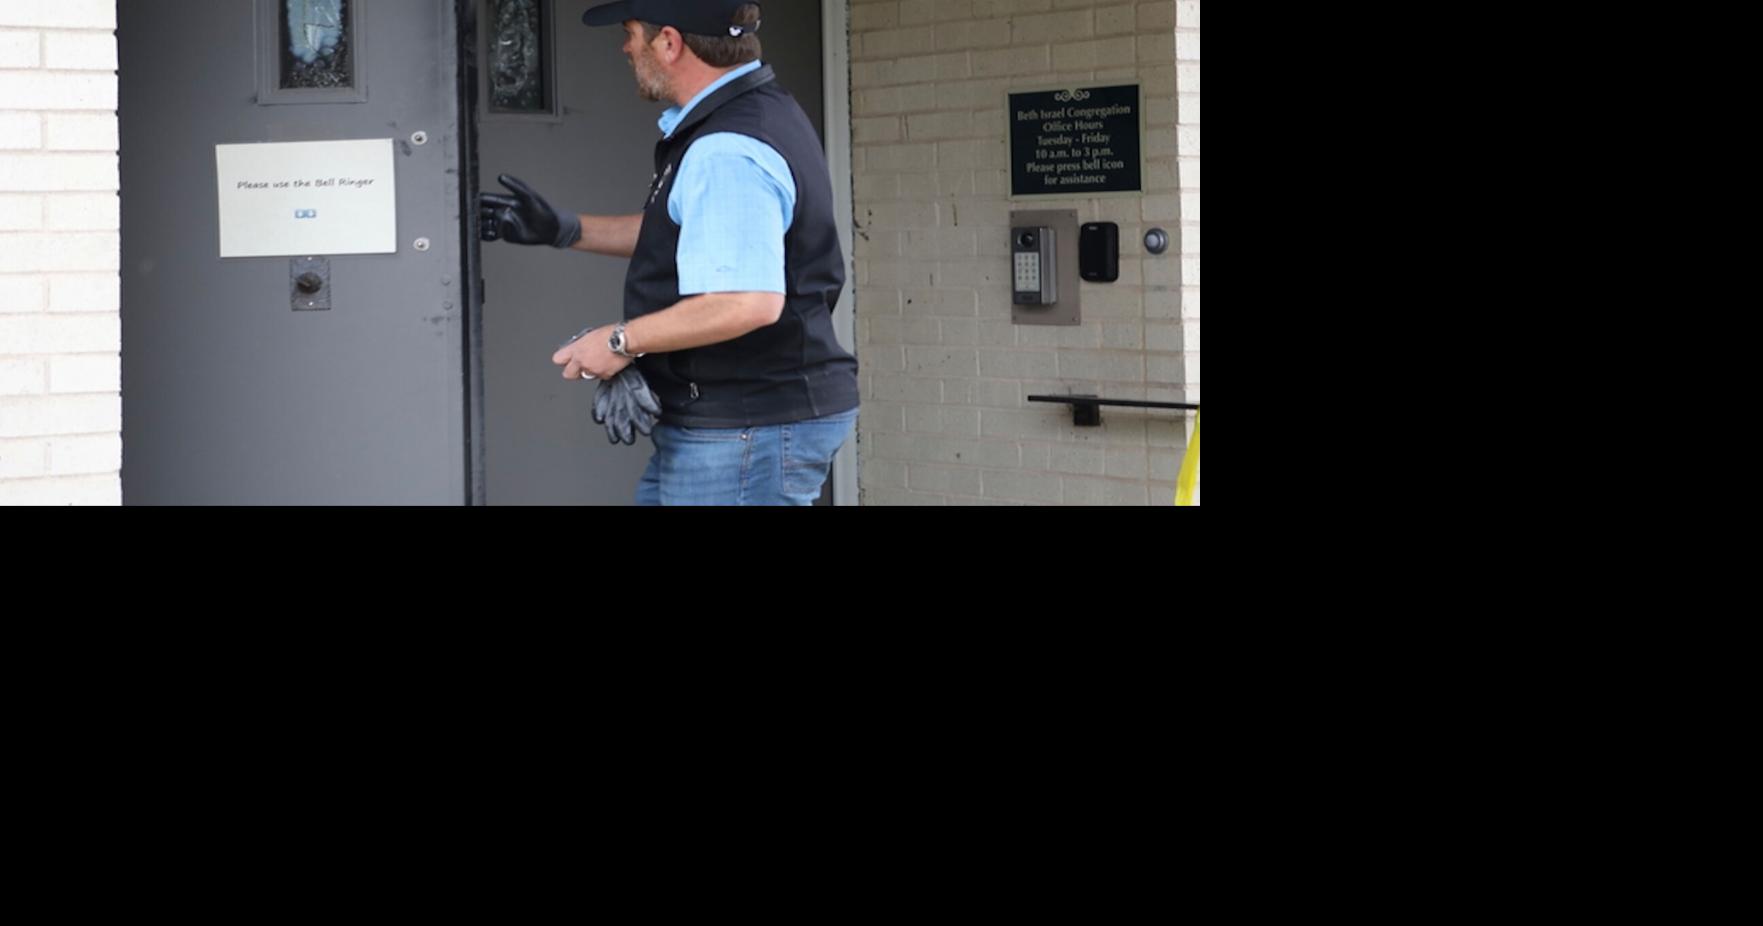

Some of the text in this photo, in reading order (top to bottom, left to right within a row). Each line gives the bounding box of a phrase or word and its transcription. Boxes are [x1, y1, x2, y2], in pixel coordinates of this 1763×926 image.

[1017, 104, 1131, 120] Beth Israel Congregation
[1042, 120, 1103, 132] Office Hours
[1038, 135, 1072, 147] Tuesday
[1081, 133, 1110, 144] Friday
[1036, 147, 1114, 159] 10 a.m. to 3 p.m.
[1026, 159, 1124, 174] Please press bell icon
[237, 181, 269, 190] Please
[293, 179, 311, 187] the
[315, 179, 335, 187] Bell
[339, 178, 375, 189] Ringer
[1044, 173, 1106, 185] for assistance
